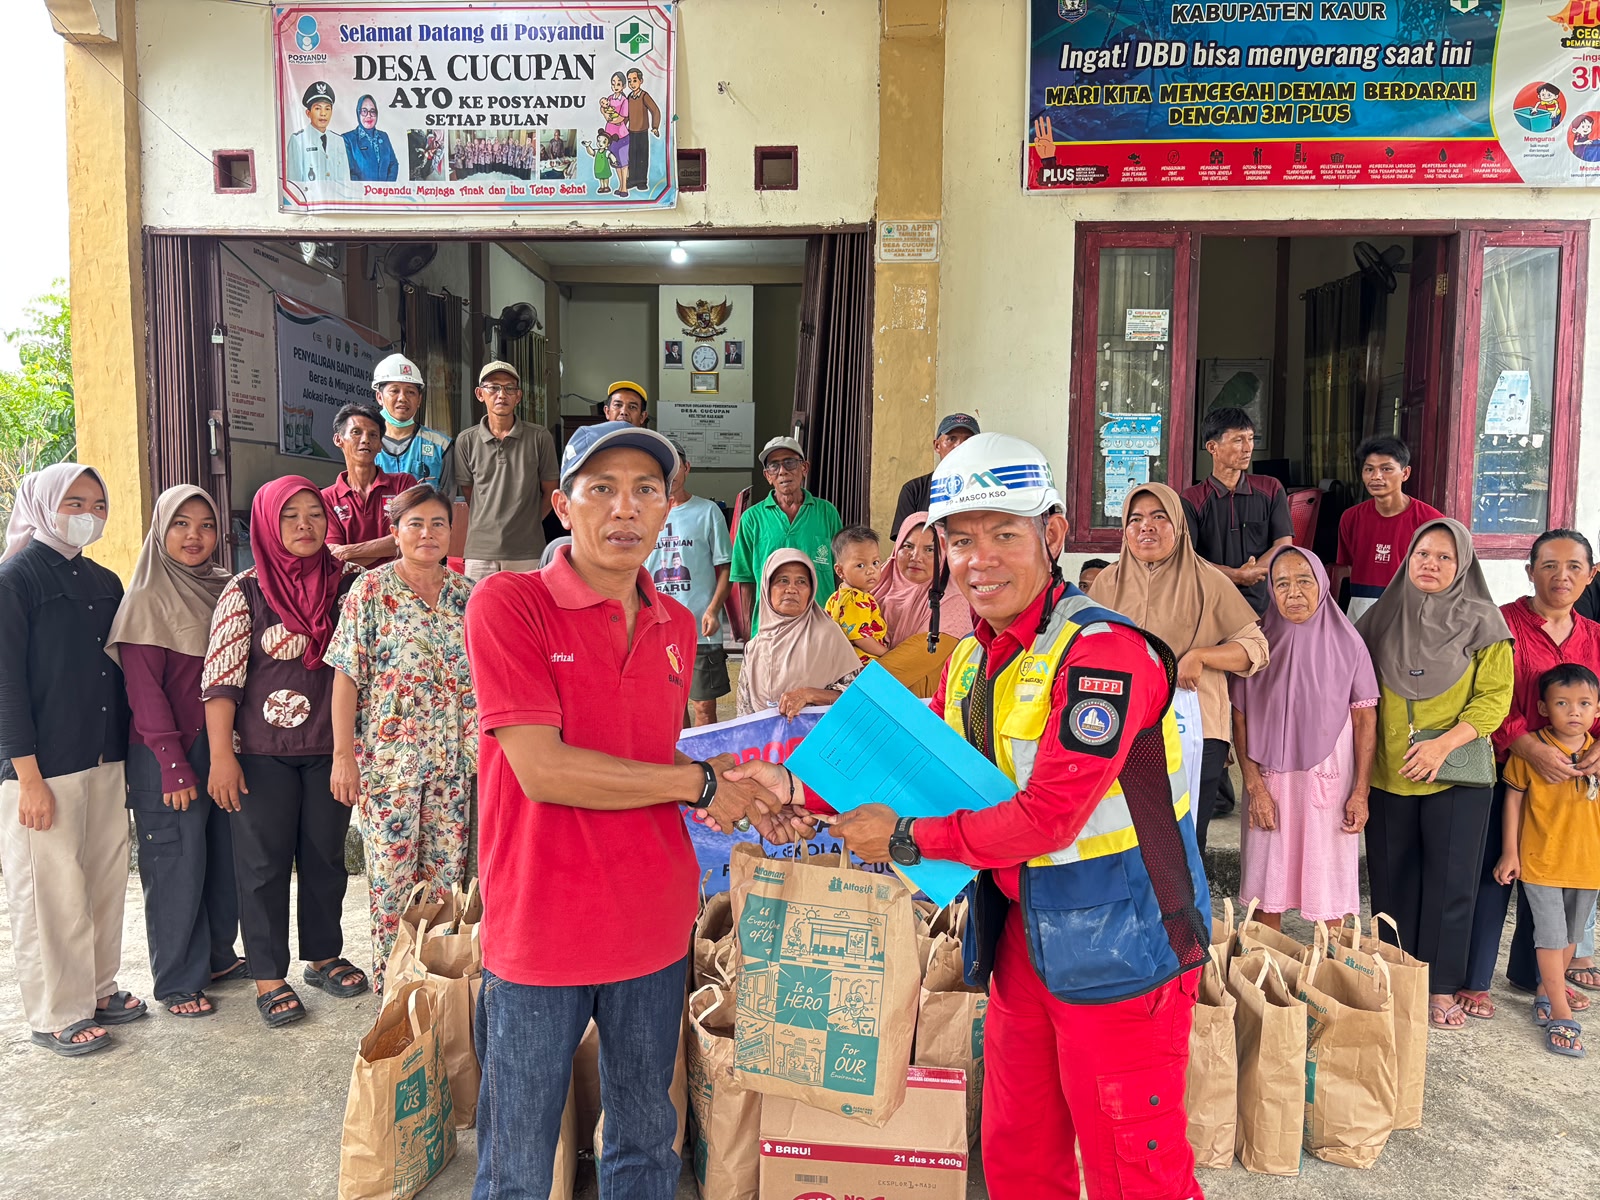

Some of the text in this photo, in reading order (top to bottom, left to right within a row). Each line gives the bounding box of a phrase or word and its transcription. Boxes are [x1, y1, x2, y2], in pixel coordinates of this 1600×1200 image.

[1171, 2, 1386, 24] KABUPATEN KAUR
[340, 24, 604, 43] Selamat Datang di Posyandu
[1060, 40, 1472, 72] Ingat! DBD bisa menyerang saat ini
[353, 54, 596, 82] DESA CUCUPAN
[389, 87, 586, 109] AYO KE POSYANDU
[1046, 82, 1476, 106] MARI KITA MENCEGAH DEMAM BERDARAH
[426, 114, 548, 126] SETIAP BULAN
[1169, 104, 1350, 126] DENGAN 3M PLUS
[1043, 168, 1074, 182] PLUS
[364, 184, 586, 197] Posyandu Menjaga Anak dan Ibu Tetap Sehat
[294, 347, 336, 371] PENYALURAN
[336, 362, 364, 380] BANTUAN
[309, 370, 327, 386] Beras
[335, 379, 355, 394] Minyak
[356, 385, 376, 402] Goreng
[303, 388, 323, 402] Alokasi
[960, 492, 987, 502] MASCO
[989, 490, 1006, 498] KSO
[666, 523, 672, 536] 1
[754, 865, 786, 879] Alfamart
[843, 882, 873, 895] Alfagift
[793, 982, 803, 993] Is
[784, 992, 822, 1011] HERO
[841, 1043, 860, 1056] For
[835, 1056, 866, 1076] OUR
[830, 1071, 866, 1084] Environment
[776, 1145, 811, 1156] BARU!
[909, 1156, 926, 1164] dus
[938, 1156, 963, 1168] 400g
